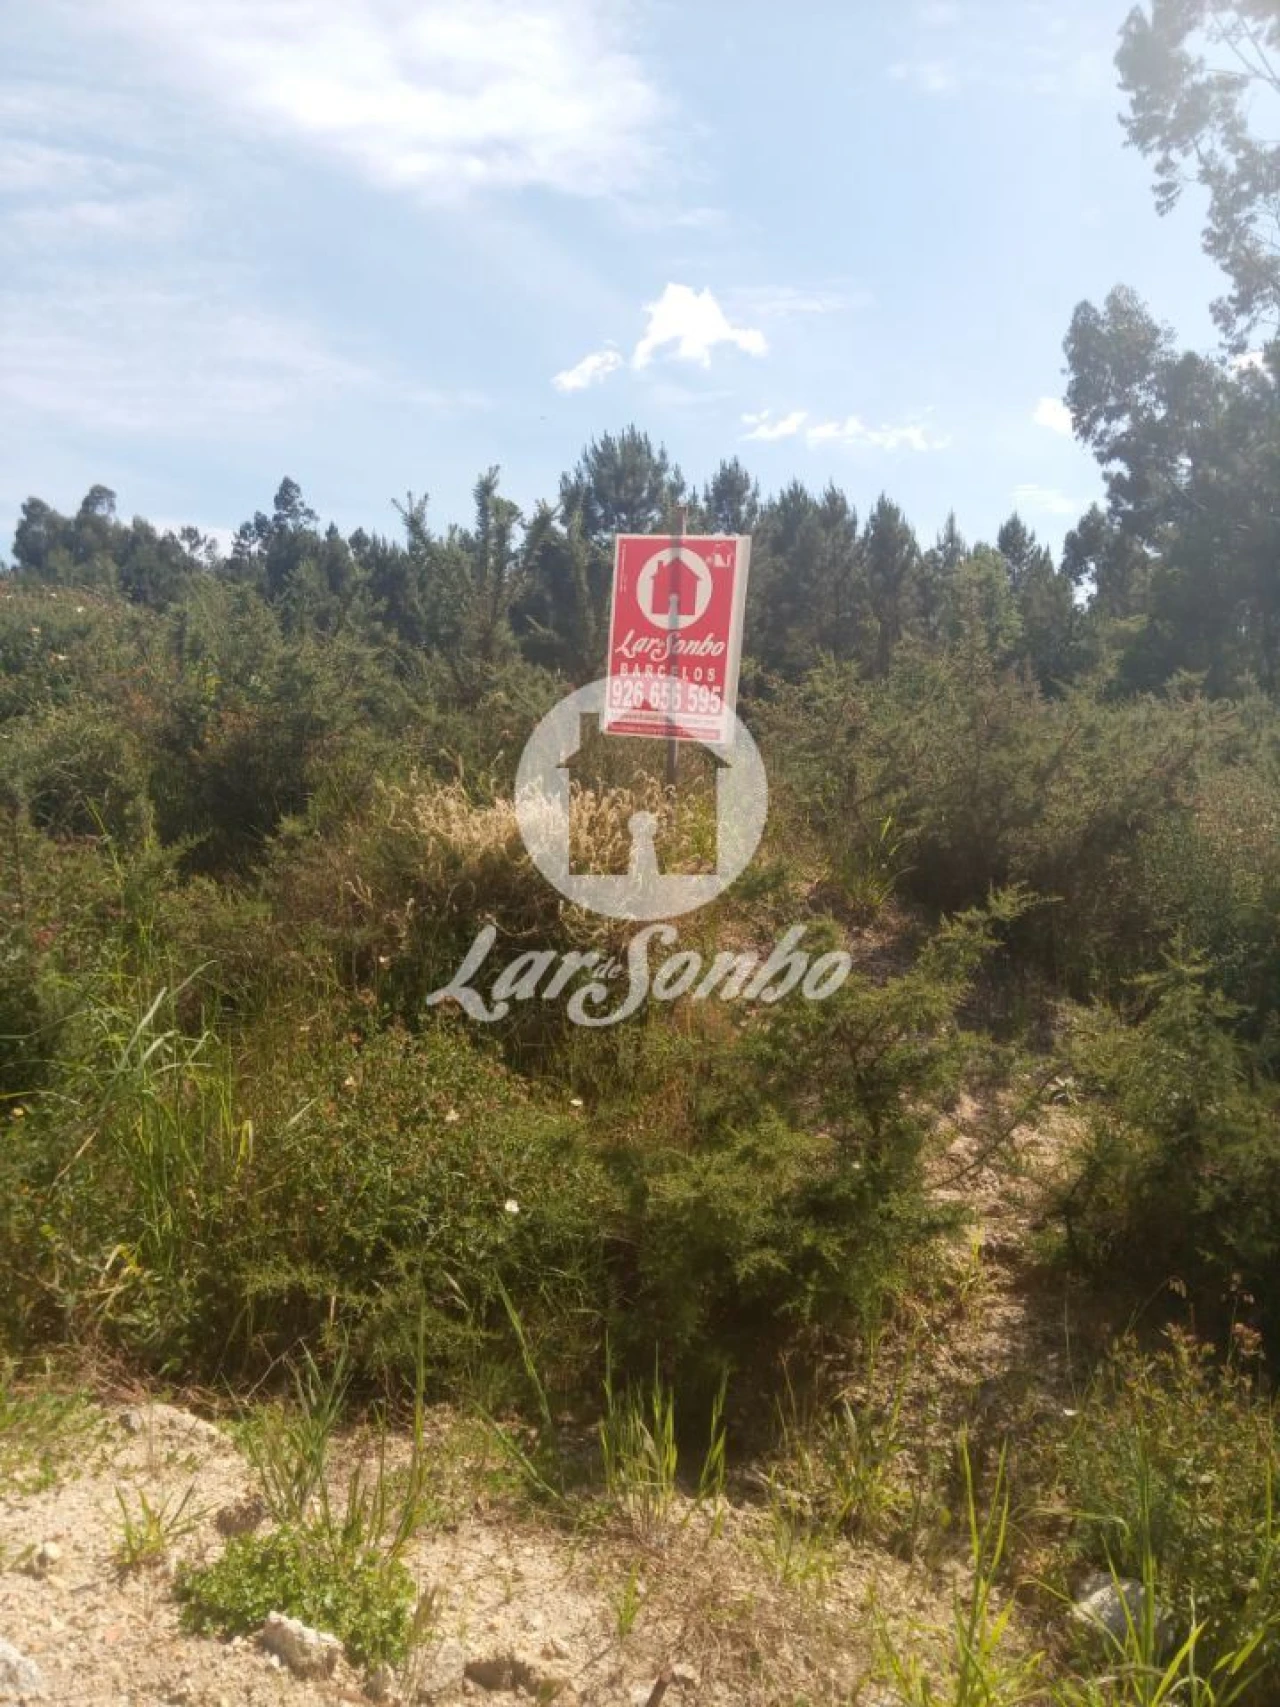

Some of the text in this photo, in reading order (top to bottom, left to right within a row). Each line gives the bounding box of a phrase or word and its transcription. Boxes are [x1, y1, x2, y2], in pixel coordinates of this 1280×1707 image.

[619, 662, 716, 681] BARCELOS
[612, 680, 645, 707] 926
[687, 684, 721, 713] 595
